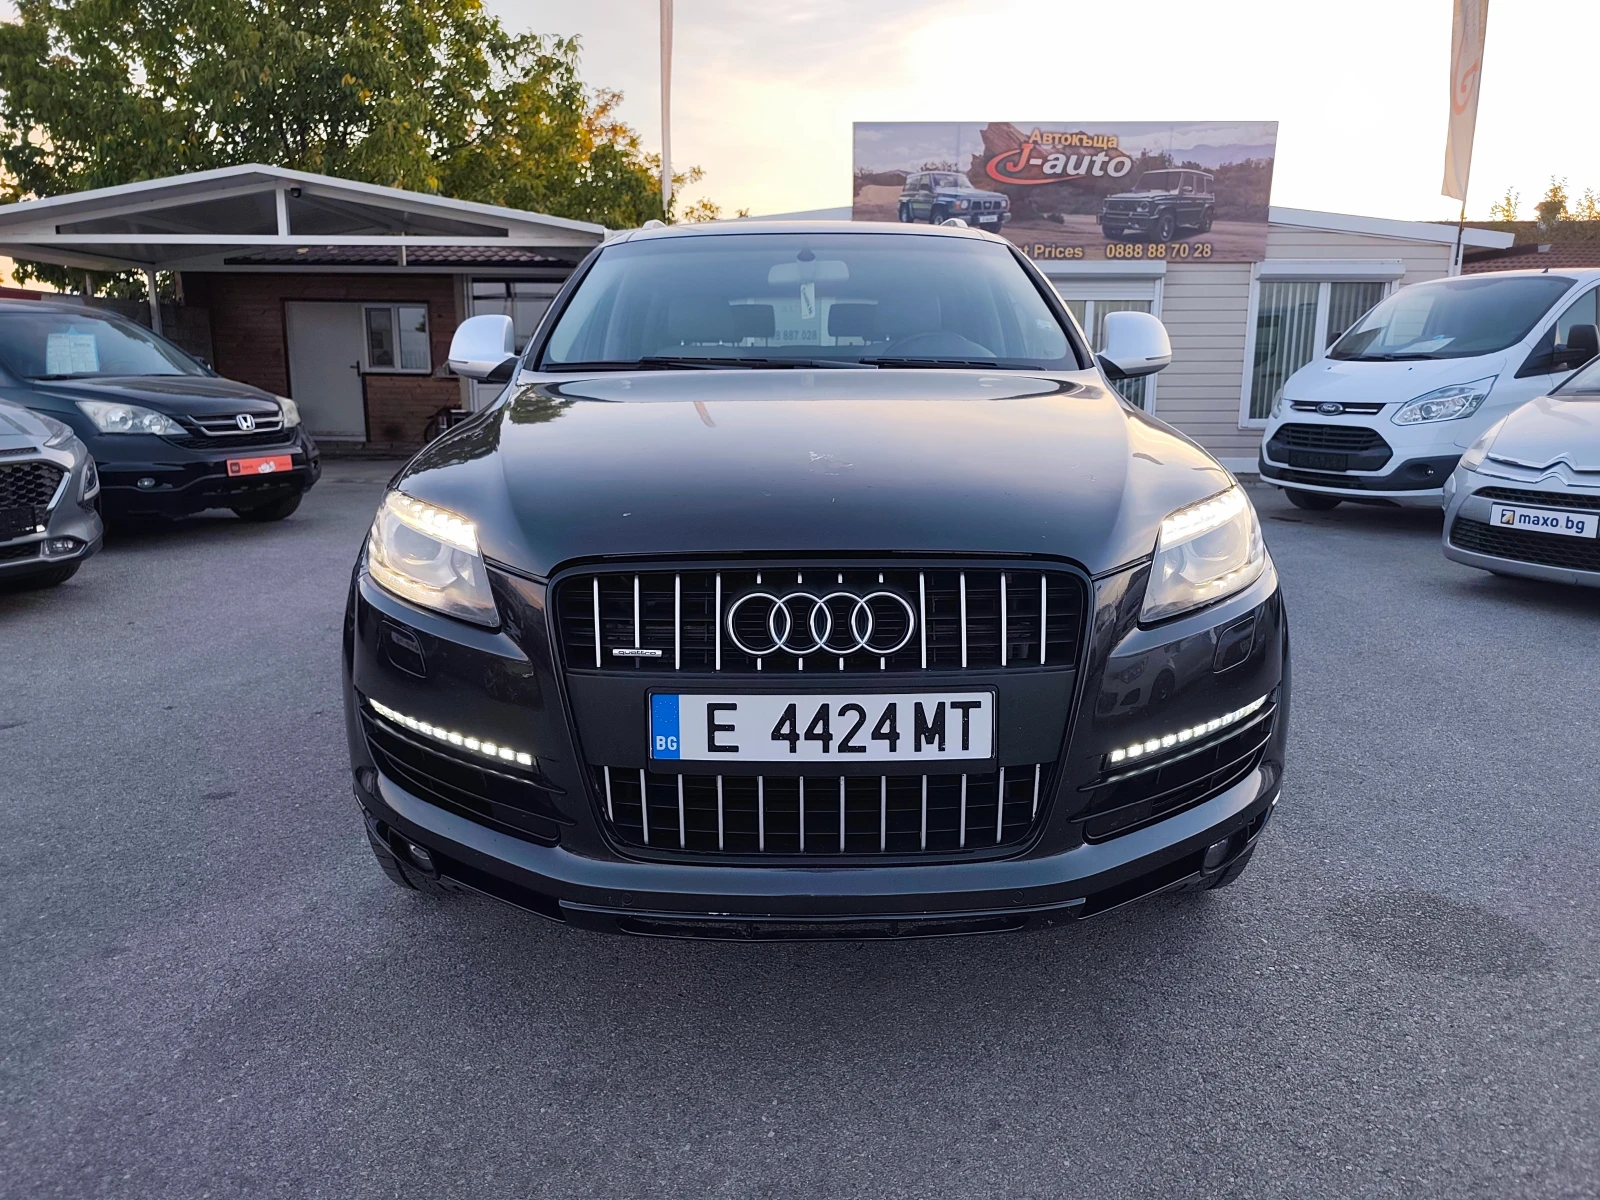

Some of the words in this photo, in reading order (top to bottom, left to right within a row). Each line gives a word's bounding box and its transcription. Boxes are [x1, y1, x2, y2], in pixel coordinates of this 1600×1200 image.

[1029, 129, 1118, 149] Автокъща
[1006, 143, 1132, 178] J-auto
[1034, 243, 1083, 258] Prices
[1106, 244, 1143, 258] 0888
[1147, 244, 1166, 258] 88
[1171, 243, 1189, 257] 70
[1193, 243, 1212, 257] 28
[1518, 513, 1586, 534] maxo.bg
[707, 703, 739, 753] E
[656, 736, 677, 750] BG
